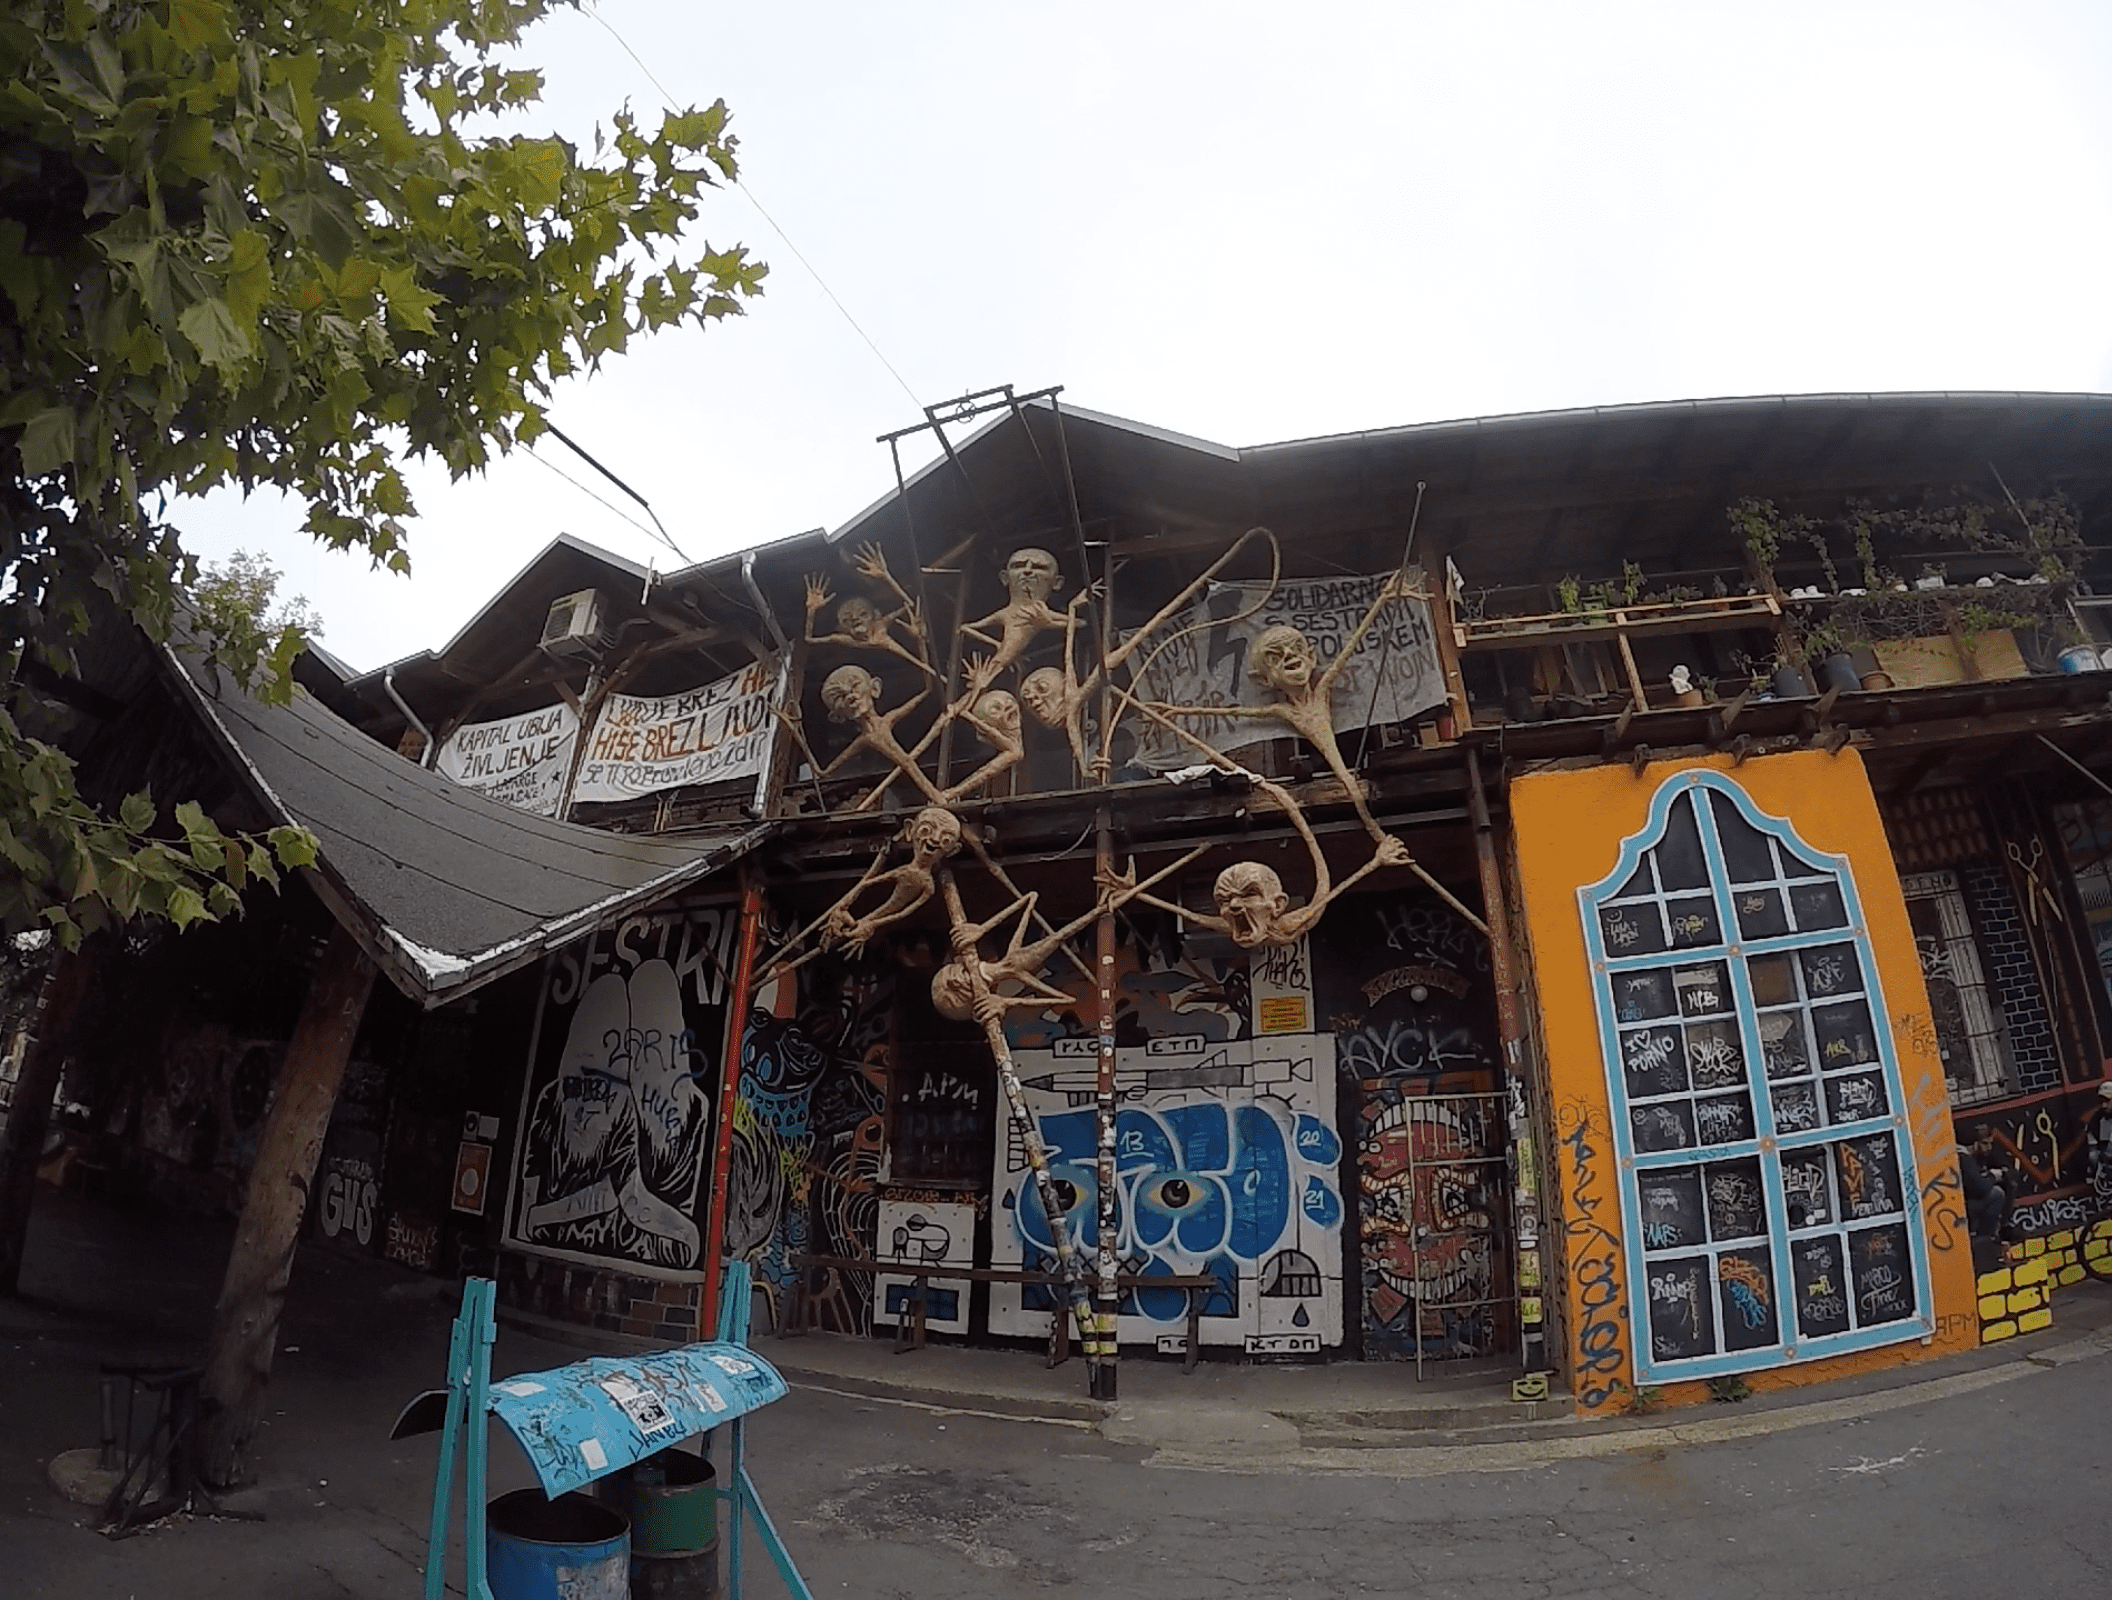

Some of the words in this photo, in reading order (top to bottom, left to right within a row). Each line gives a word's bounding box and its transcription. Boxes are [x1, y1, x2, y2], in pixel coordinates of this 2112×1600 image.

[456, 722, 512, 753] KAPITAL
[516, 708, 563, 741] UBIJA
[642, 716, 697, 761] BREZ
[1625, 1039, 1638, 1053] I
[1628, 1035, 1675, 1073] PORNO
[1120, 1131, 1145, 1152] 13
